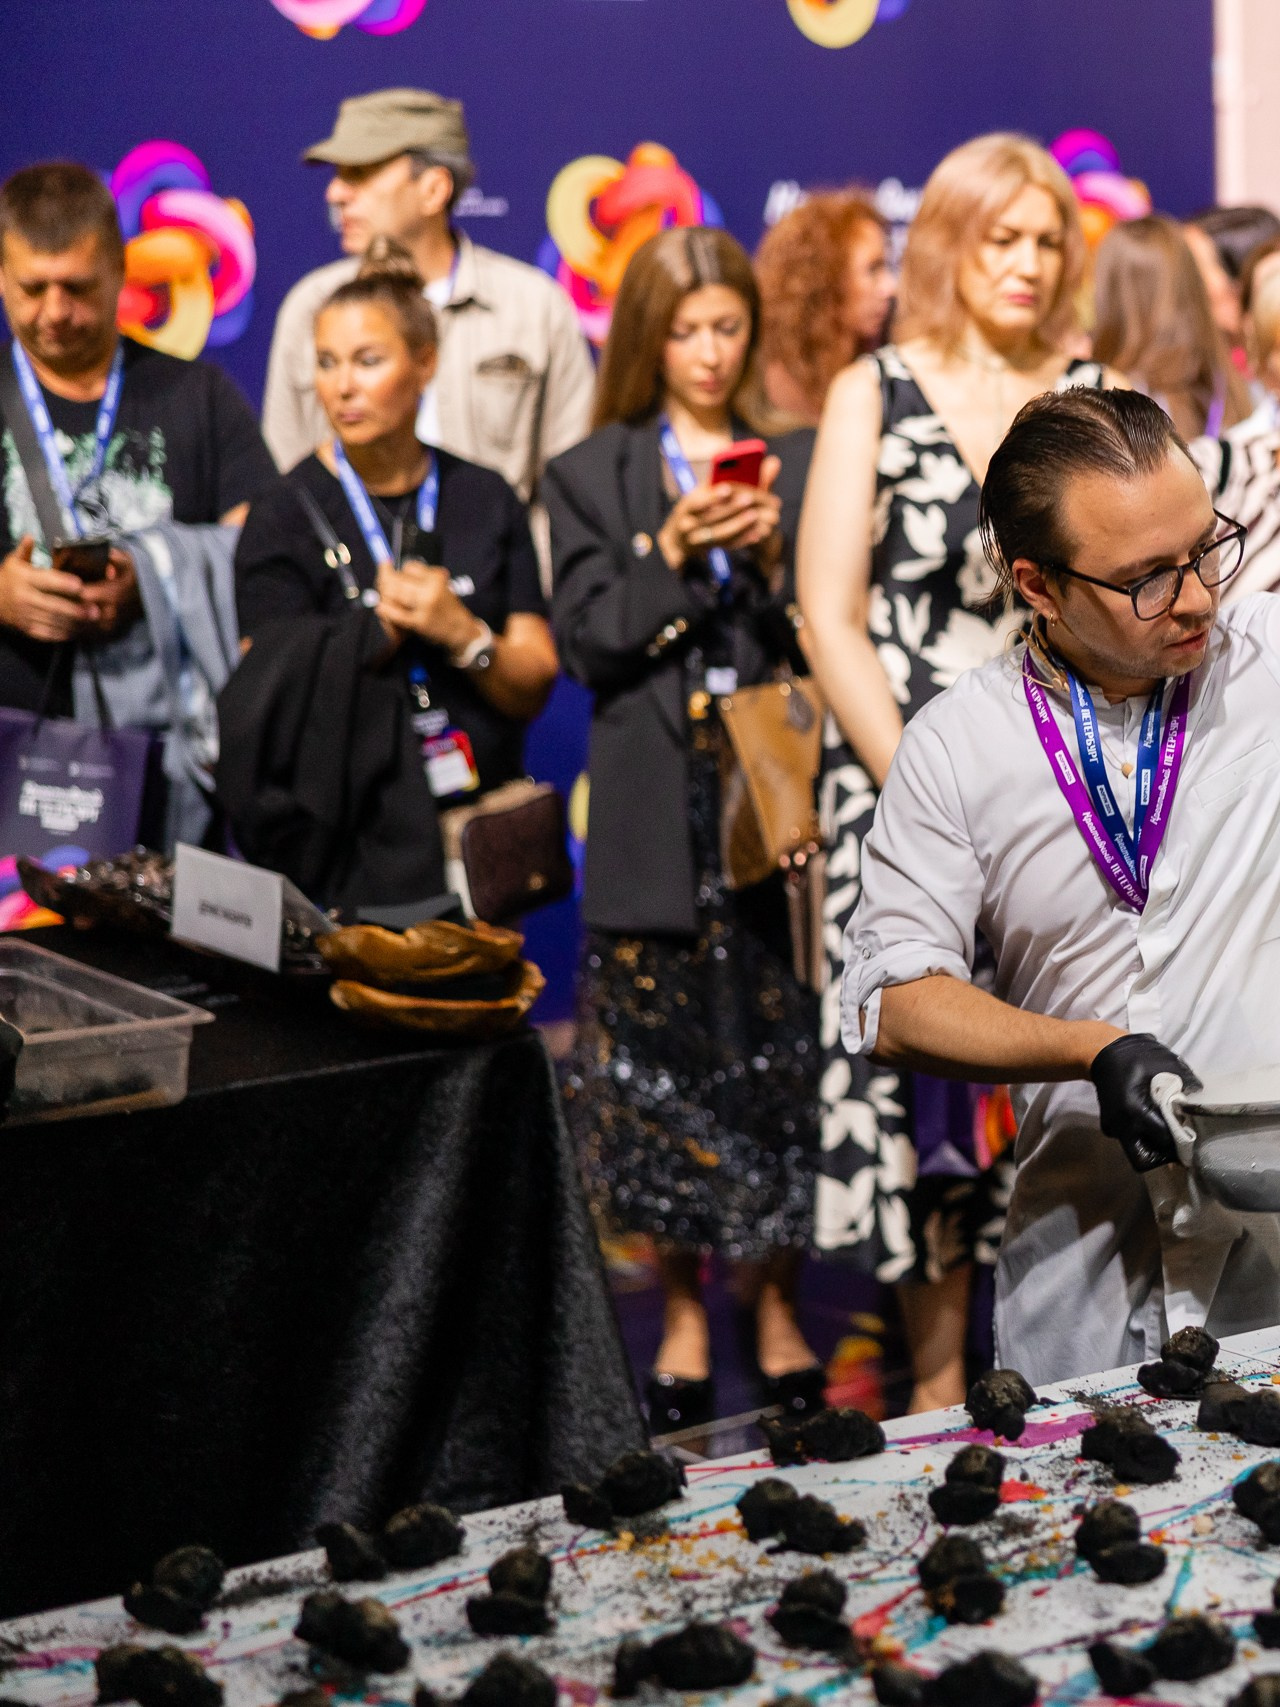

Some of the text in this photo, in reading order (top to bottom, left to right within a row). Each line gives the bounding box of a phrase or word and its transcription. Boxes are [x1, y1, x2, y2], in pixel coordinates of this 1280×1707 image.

[1080, 708, 1099, 764] ПЕТЕРБУРГ
[1163, 715, 1180, 767] ПЕТЕРБУРГ
[1082, 811, 1115, 864] Креативный
[1114, 832, 1138, 882] Креативн
